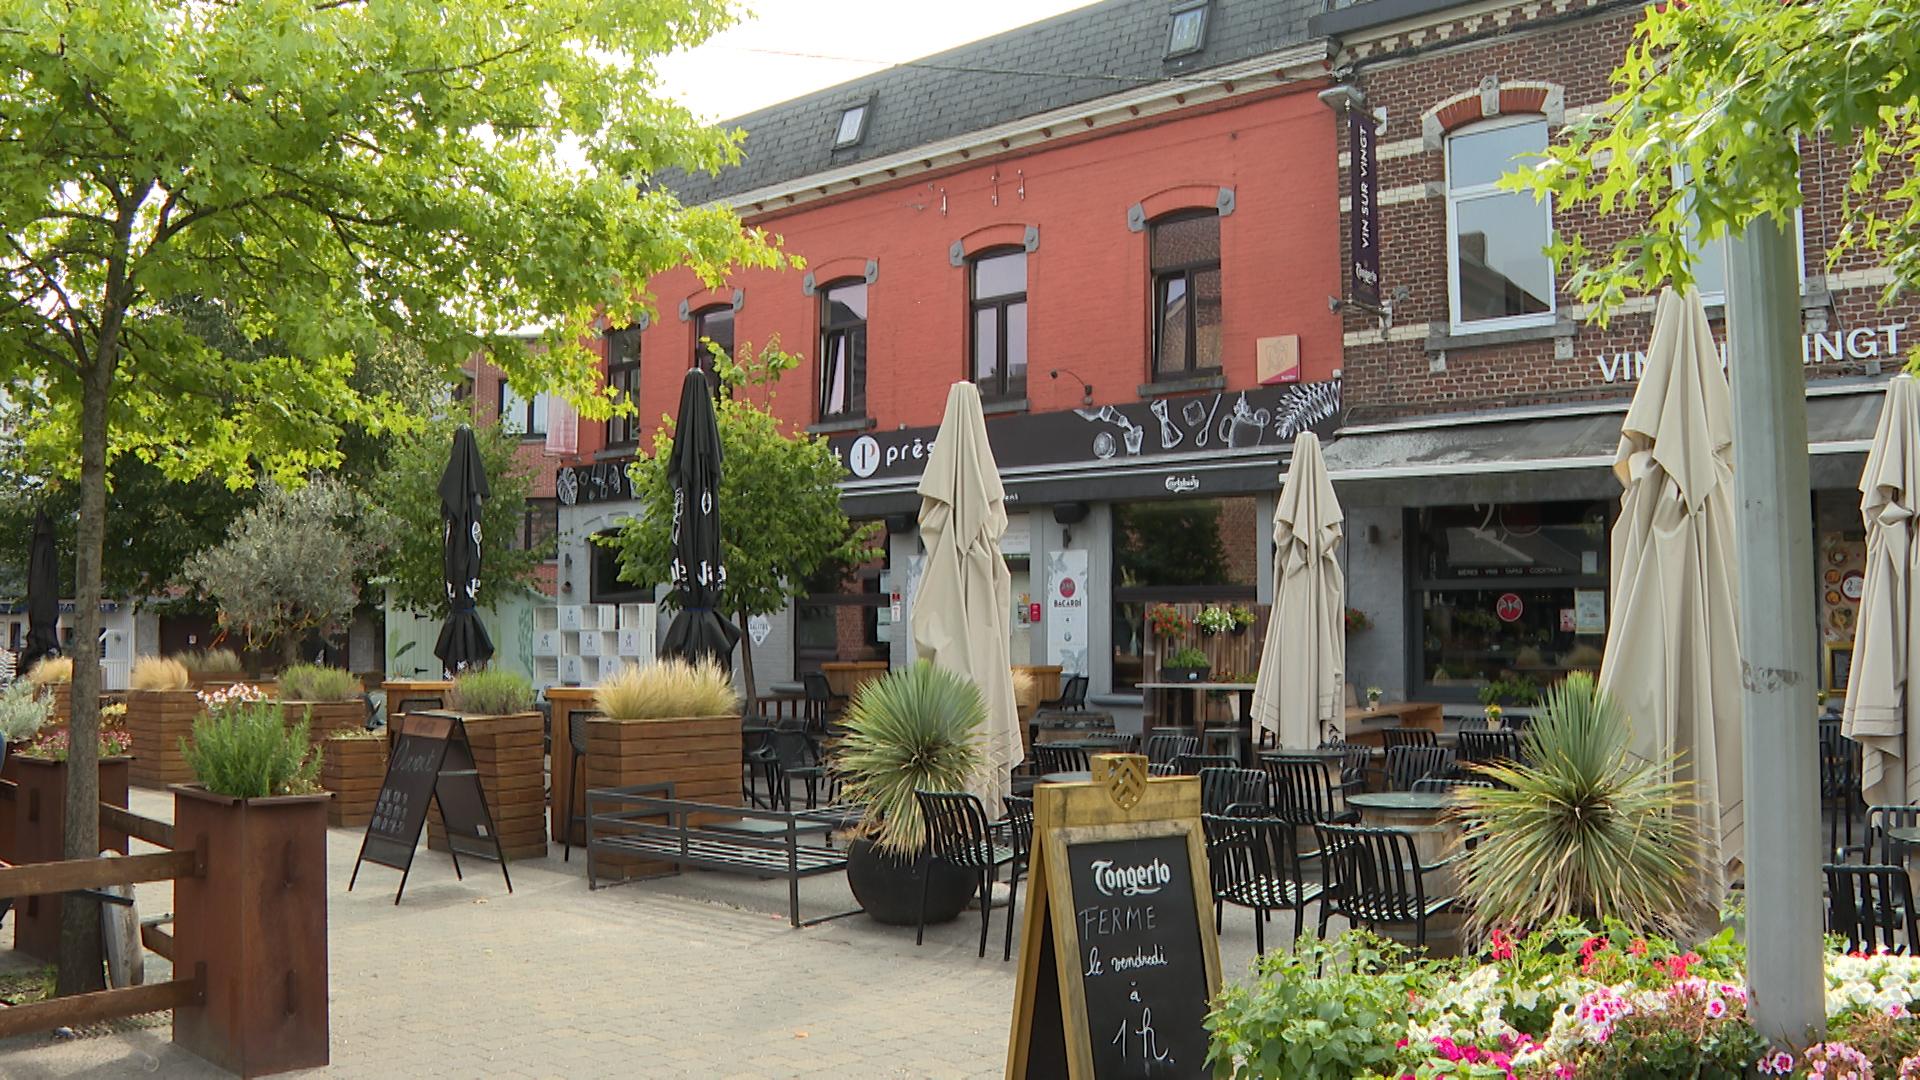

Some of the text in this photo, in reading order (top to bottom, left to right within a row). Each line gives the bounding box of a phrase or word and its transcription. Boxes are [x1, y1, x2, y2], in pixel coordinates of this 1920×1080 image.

[1358, 125, 1369, 178] VINGT
[1360, 181, 1370, 217] SUR
[1361, 219, 1370, 249] VIN
[1801, 323, 1906, 364] INGT
[1090, 857, 1171, 897] Tongerlo
[1085, 943, 1168, 976] le vendredi
